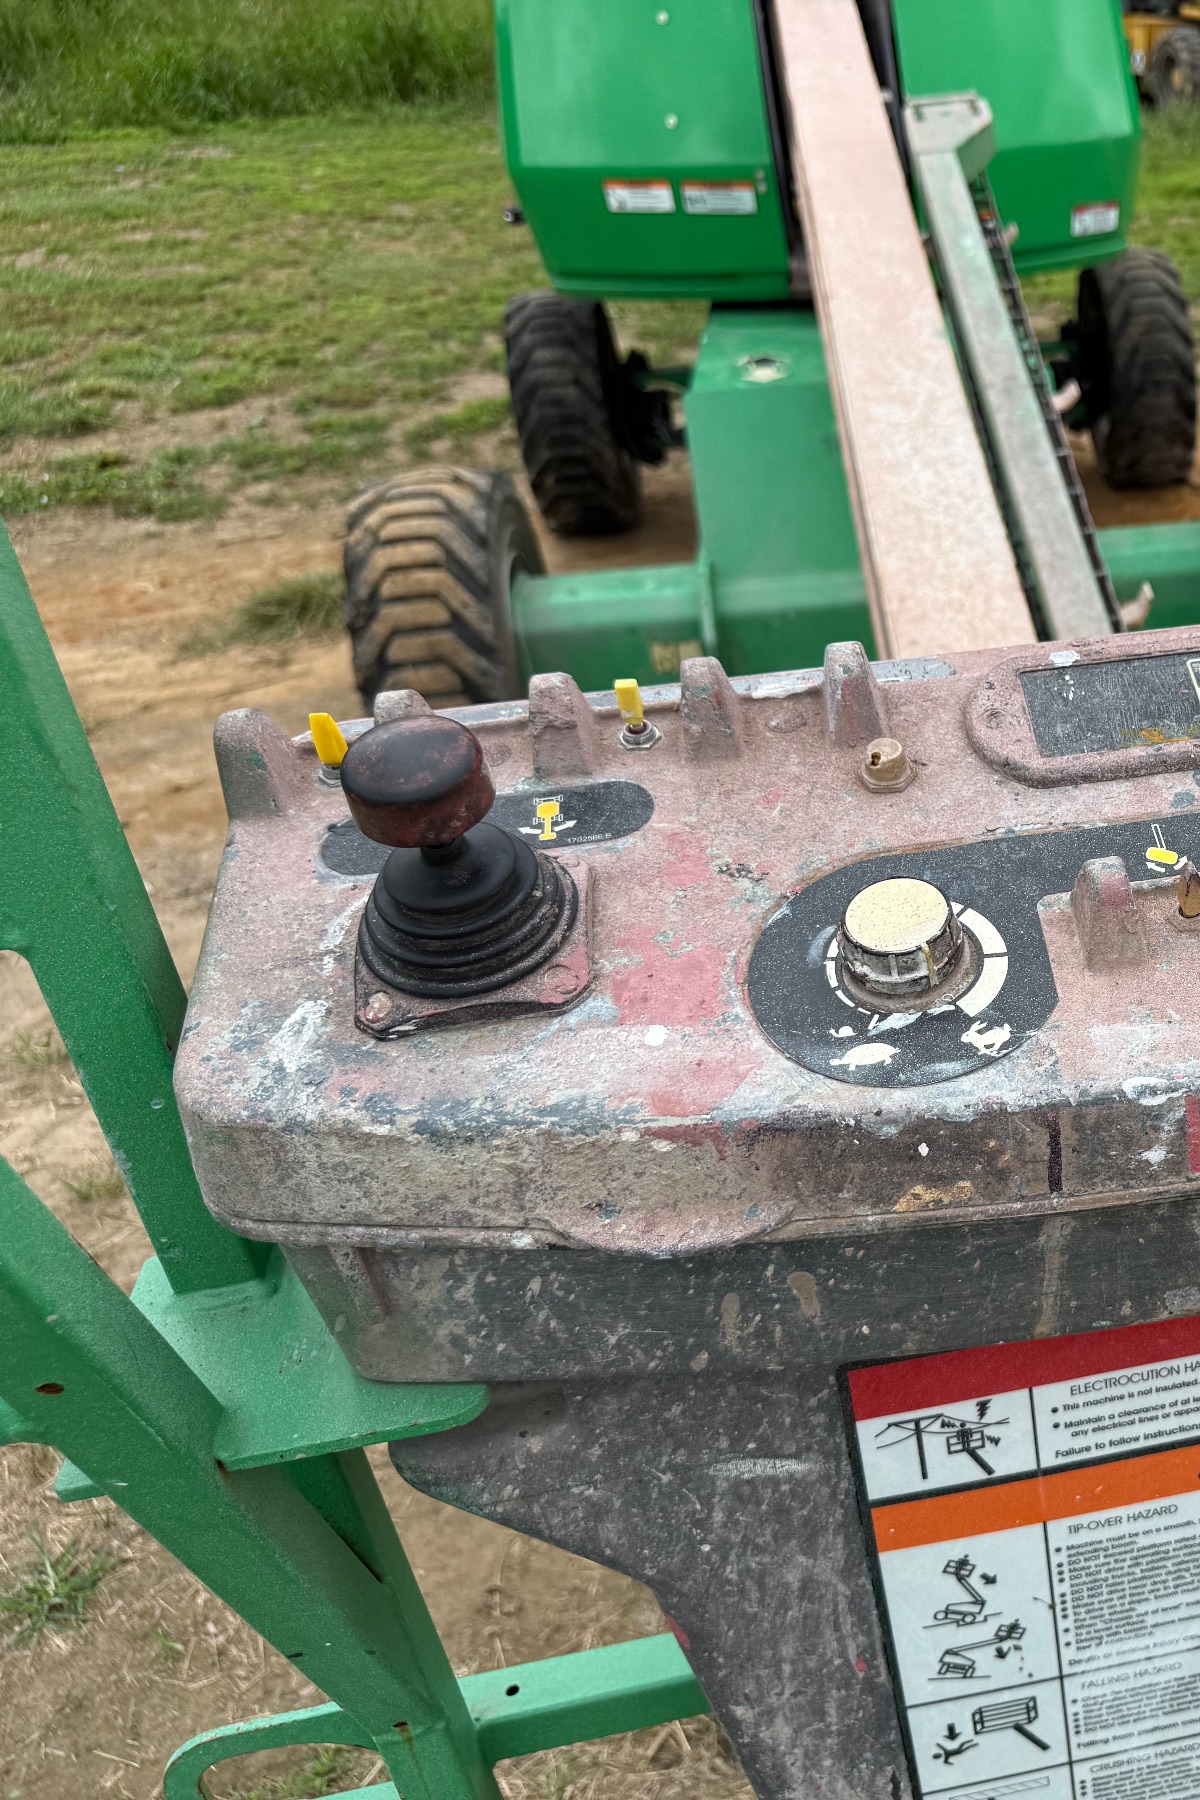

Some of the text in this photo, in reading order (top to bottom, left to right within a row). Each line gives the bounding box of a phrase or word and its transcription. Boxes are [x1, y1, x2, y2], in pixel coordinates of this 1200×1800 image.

[1062, 1403, 1080, 1411] This
[1082, 1394, 1125, 1407] machine
[1137, 1387, 1152, 1396] not
[1155, 1378, 1200, 1393] insulated.
[1070, 1365, 1180, 1396] ELECTROCUTION
[1064, 1415, 1106, 1429] Maintain
[1117, 1403, 1166, 1418] clearance
[1169, 1399, 1178, 1408] of
[1180, 1397, 1190, 1406] at
[1071, 1428, 1089, 1437] any
[1091, 1417, 1136, 1433] electrical
[1138, 1414, 1159, 1424] lines
[1055, 1445, 1091, 1458] Failure
[1109, 1435, 1140, 1447] follow
[1068, 1504, 1178, 1534] TIP-OVER HAZARD
[1066, 1539, 1104, 1551] Machine
[1105, 1534, 1126, 1543] must
[1083, 1553, 1101, 1563] NOT
[1103, 1547, 1135, 1559] exceed
[1136, 1540, 1172, 1553] platform
[1174, 1534, 1197, 1544] rated
[1081, 1662, 1182, 1690] FALLING HAZARD
[1089, 1742, 1200, 1773] CRUSHING HAZARD
